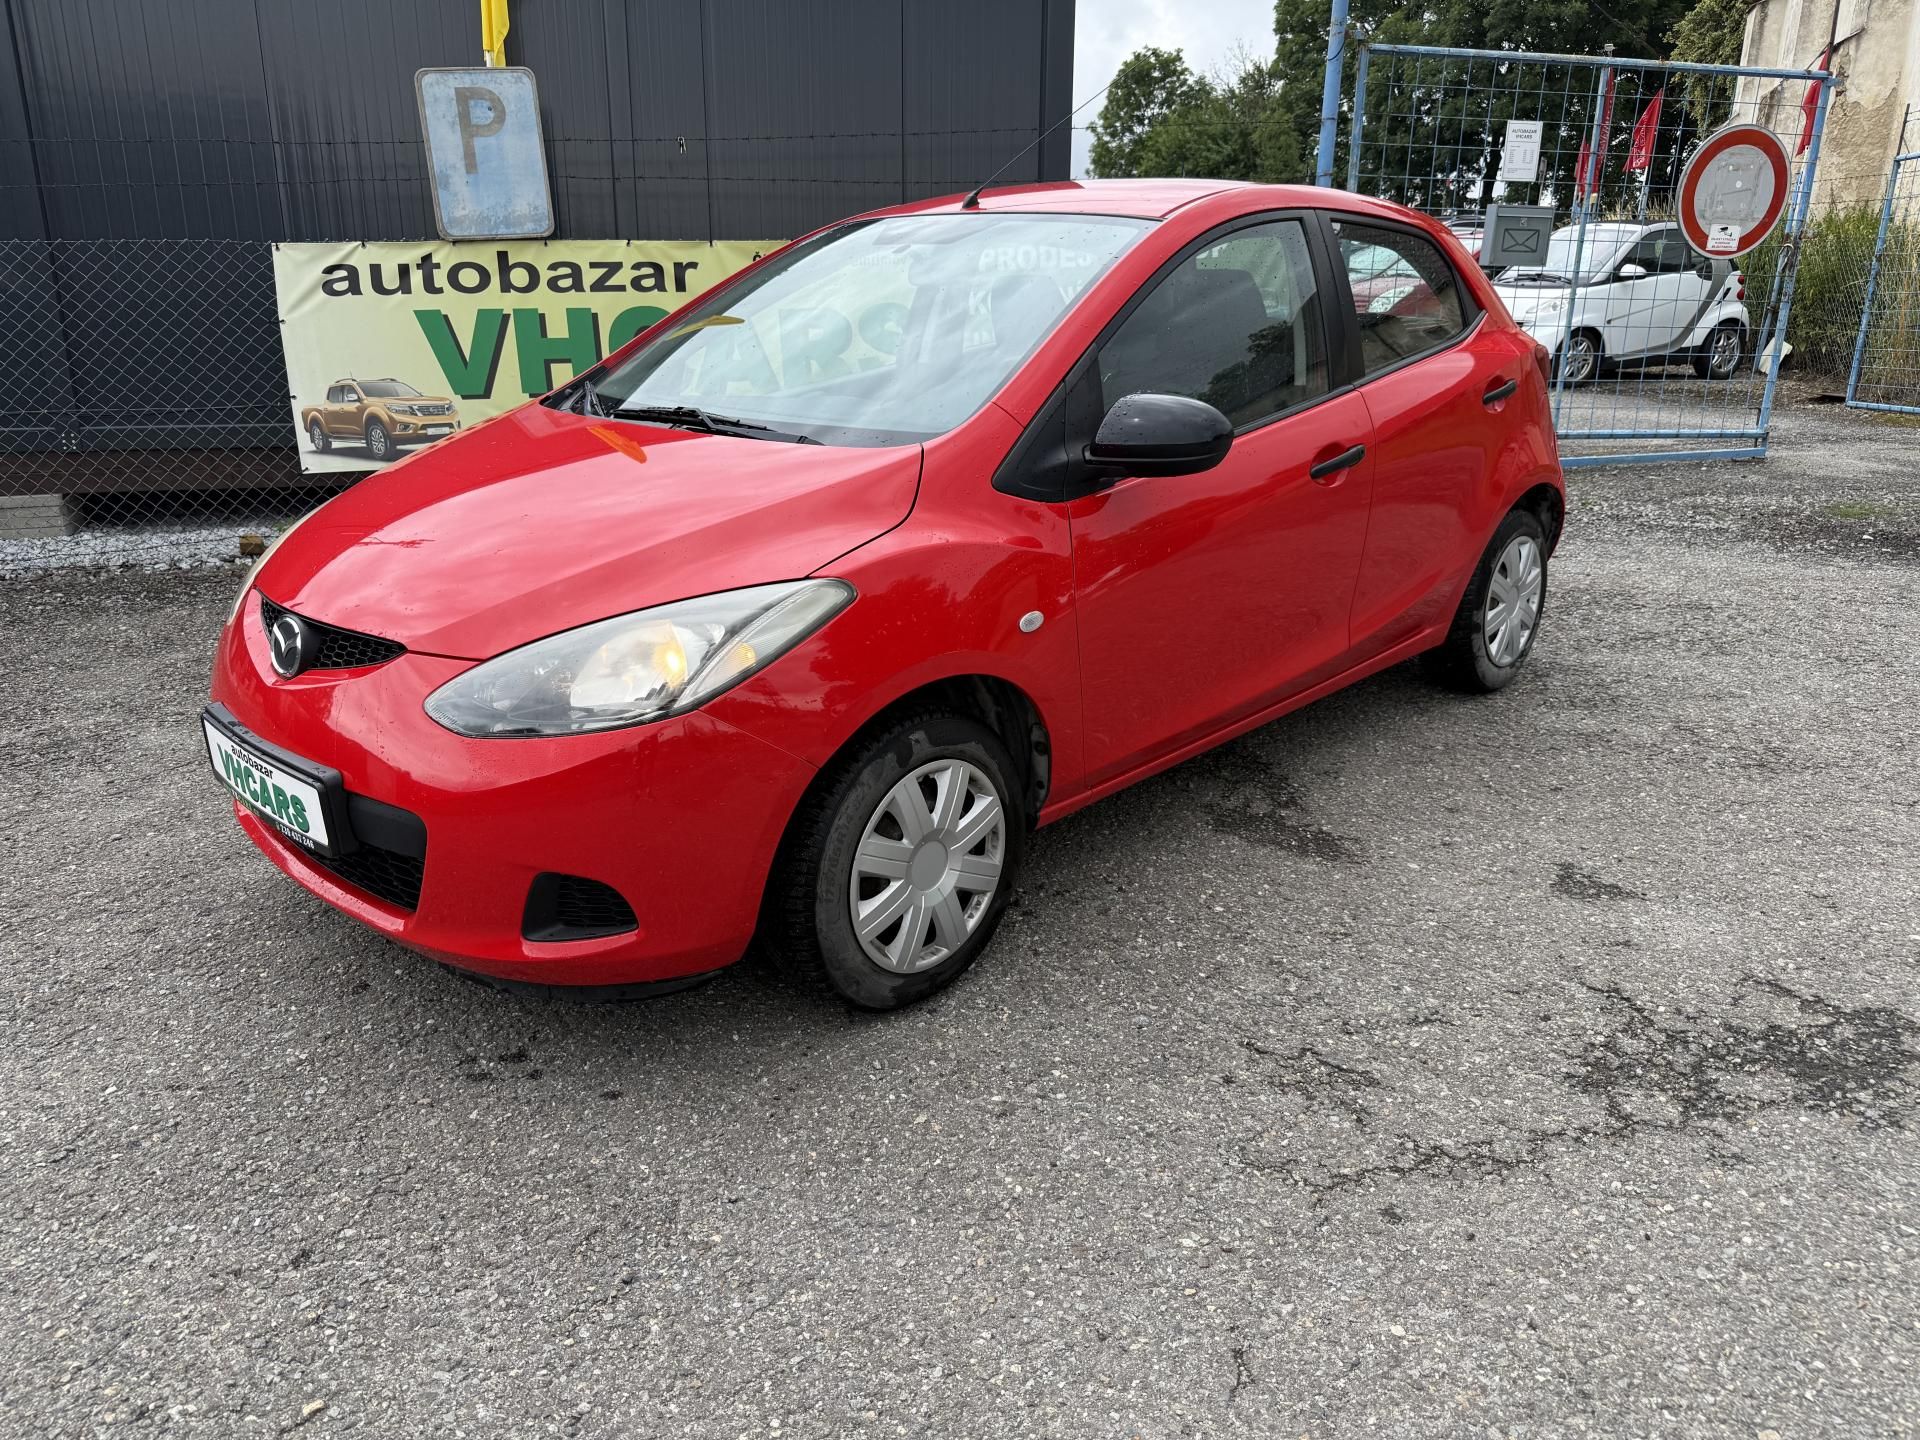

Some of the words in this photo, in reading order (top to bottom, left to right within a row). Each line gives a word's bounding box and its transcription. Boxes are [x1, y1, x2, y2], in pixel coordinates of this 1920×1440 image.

[454, 86, 506, 174] P
[321, 250, 699, 297] autobazar
[216, 741, 310, 833] VHCARS
[231, 744, 274, 780] autobazar
